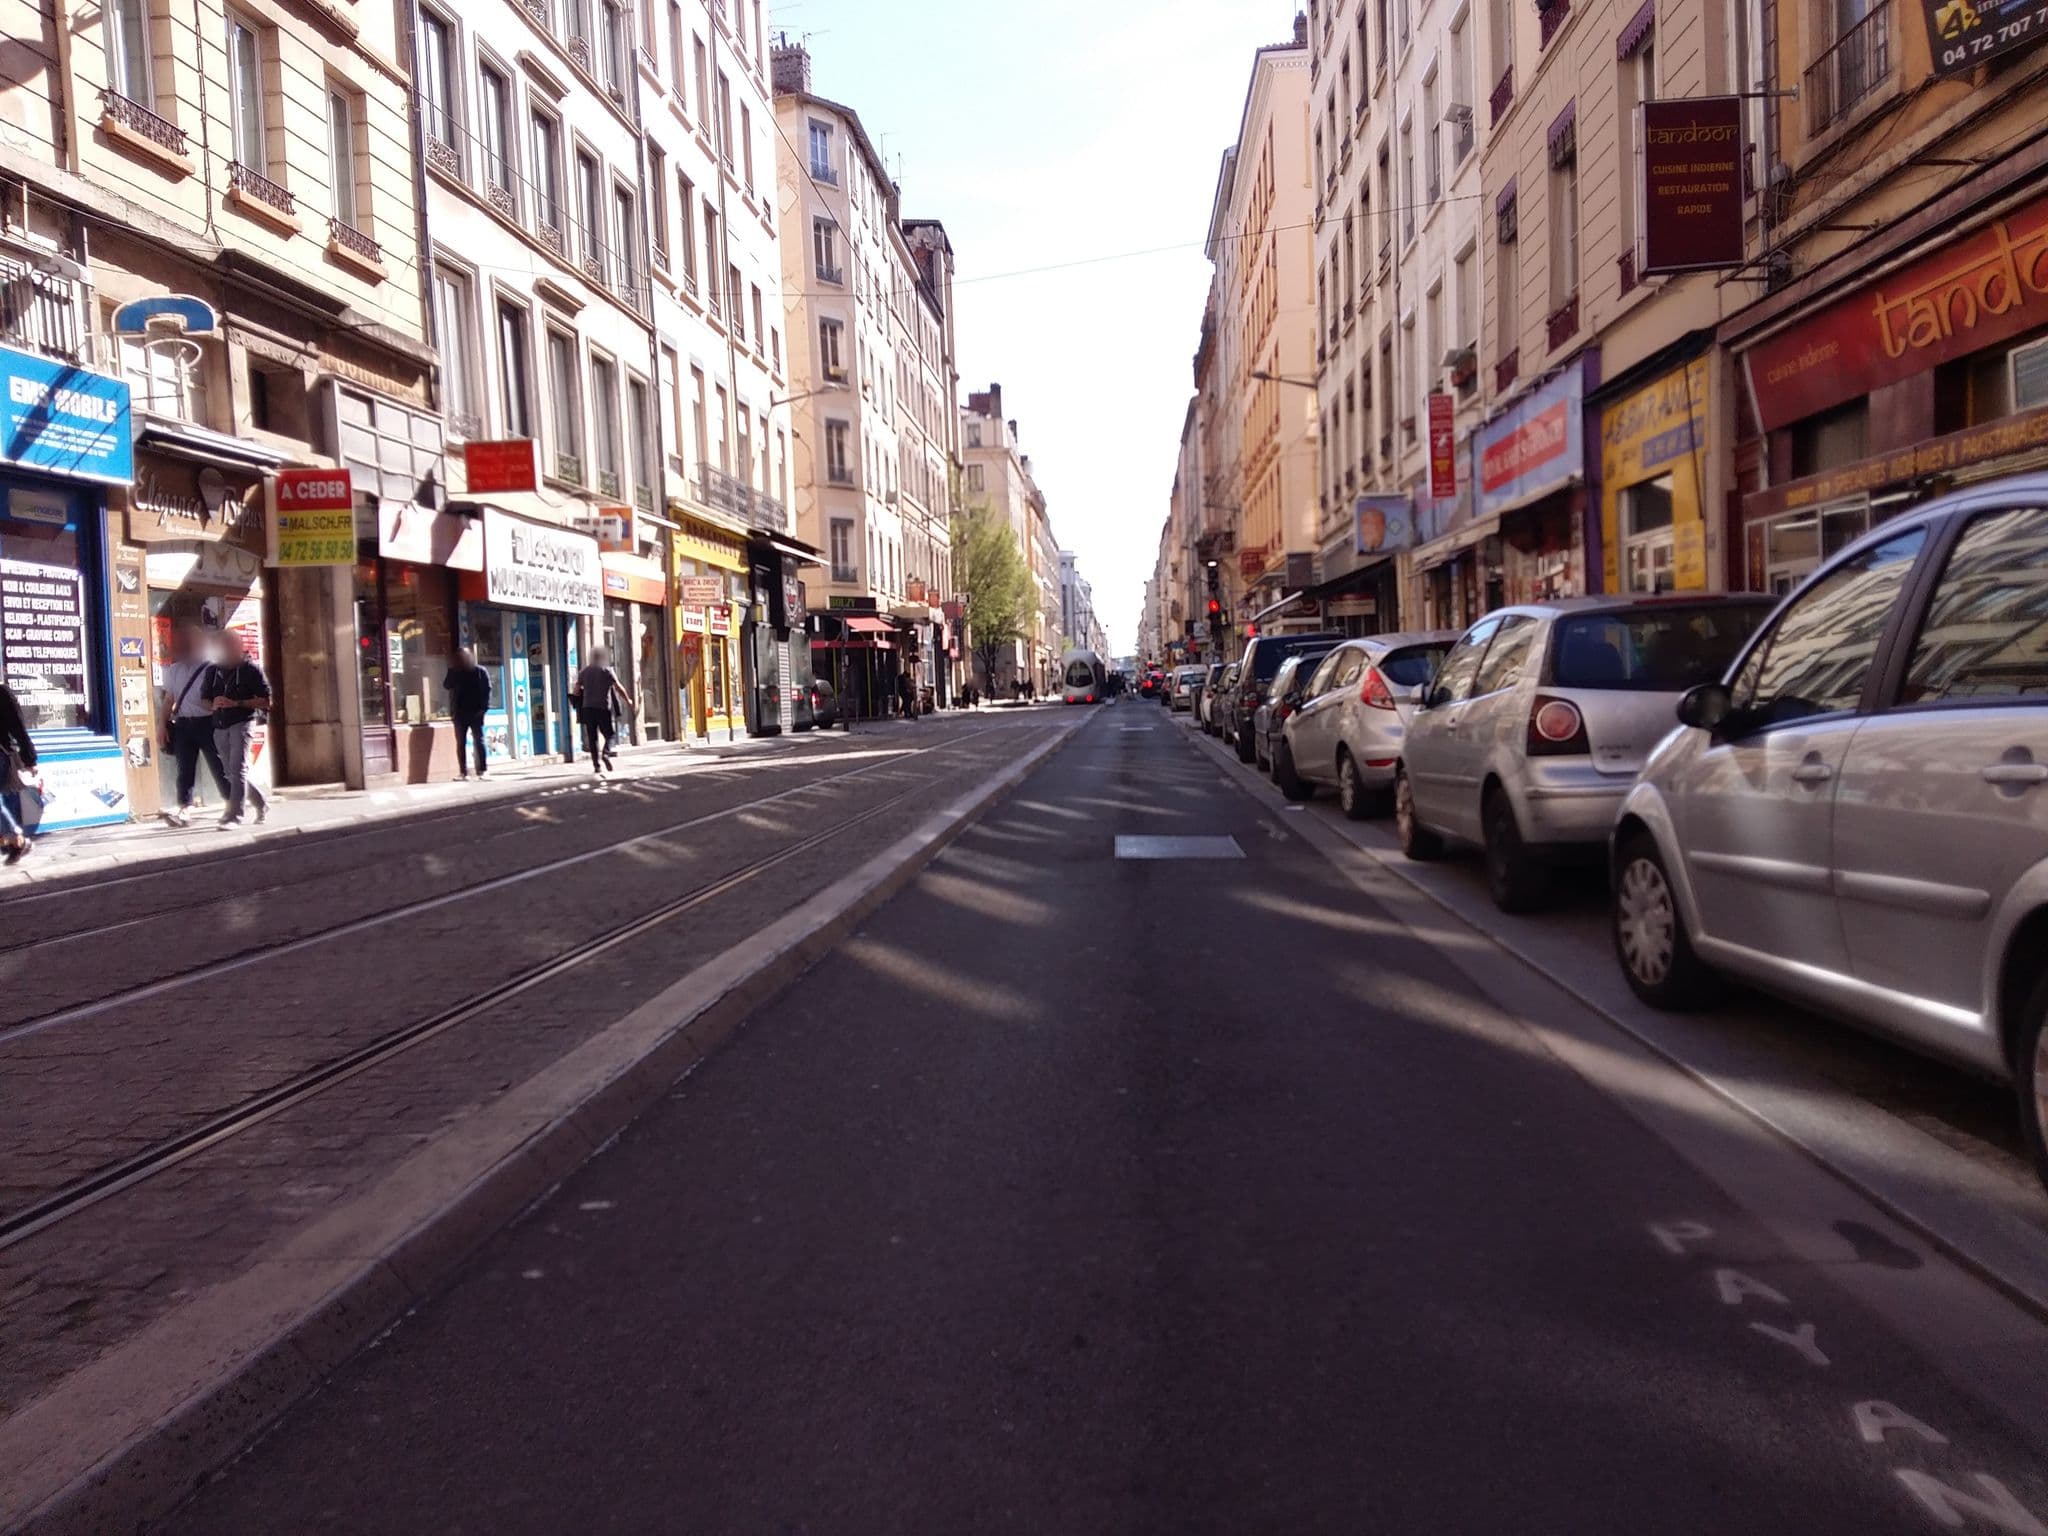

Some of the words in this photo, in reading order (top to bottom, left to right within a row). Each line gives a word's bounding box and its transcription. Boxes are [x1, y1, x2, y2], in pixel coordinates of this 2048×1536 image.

[1943, 45, 1966, 65] 04
[1970, 34, 1995, 54] 72
[1997, 16, 2032, 42] 707
[1653, 164, 1689, 175] CUISINE
[1691, 161, 1735, 173] INDIENNE
[1658, 182, 1729, 195] RESTAURATION
[1677, 204, 1712, 215] RAPIDE
[54, 387, 117, 423] MOBILE
[281, 482, 293, 499] A
[296, 480, 347, 499] CEDER
